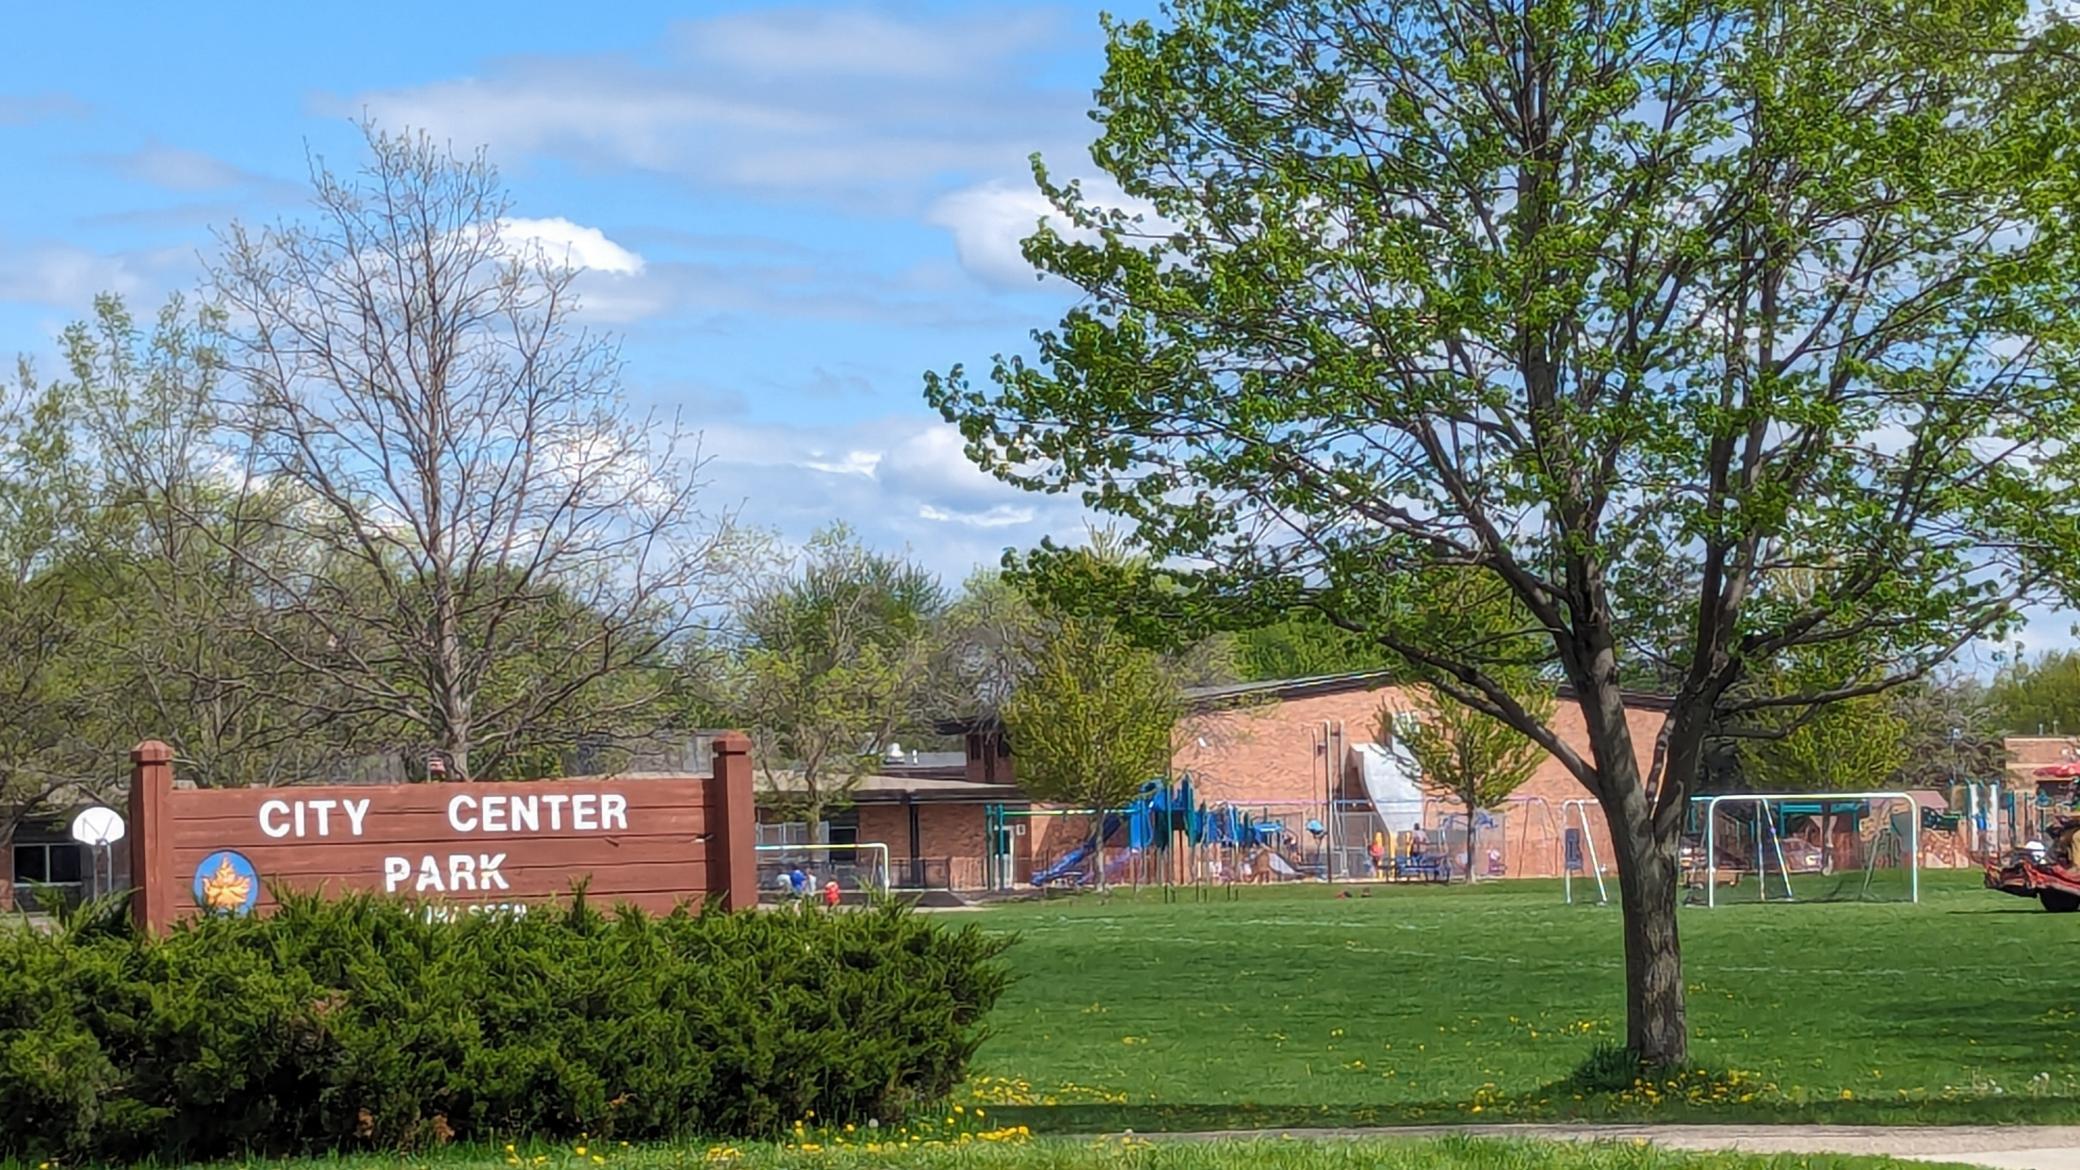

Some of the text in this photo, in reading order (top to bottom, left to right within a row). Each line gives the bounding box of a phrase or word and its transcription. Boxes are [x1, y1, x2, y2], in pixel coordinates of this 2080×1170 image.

[258, 793, 628, 838] CITY CENTER
[384, 853, 509, 893] PARK
